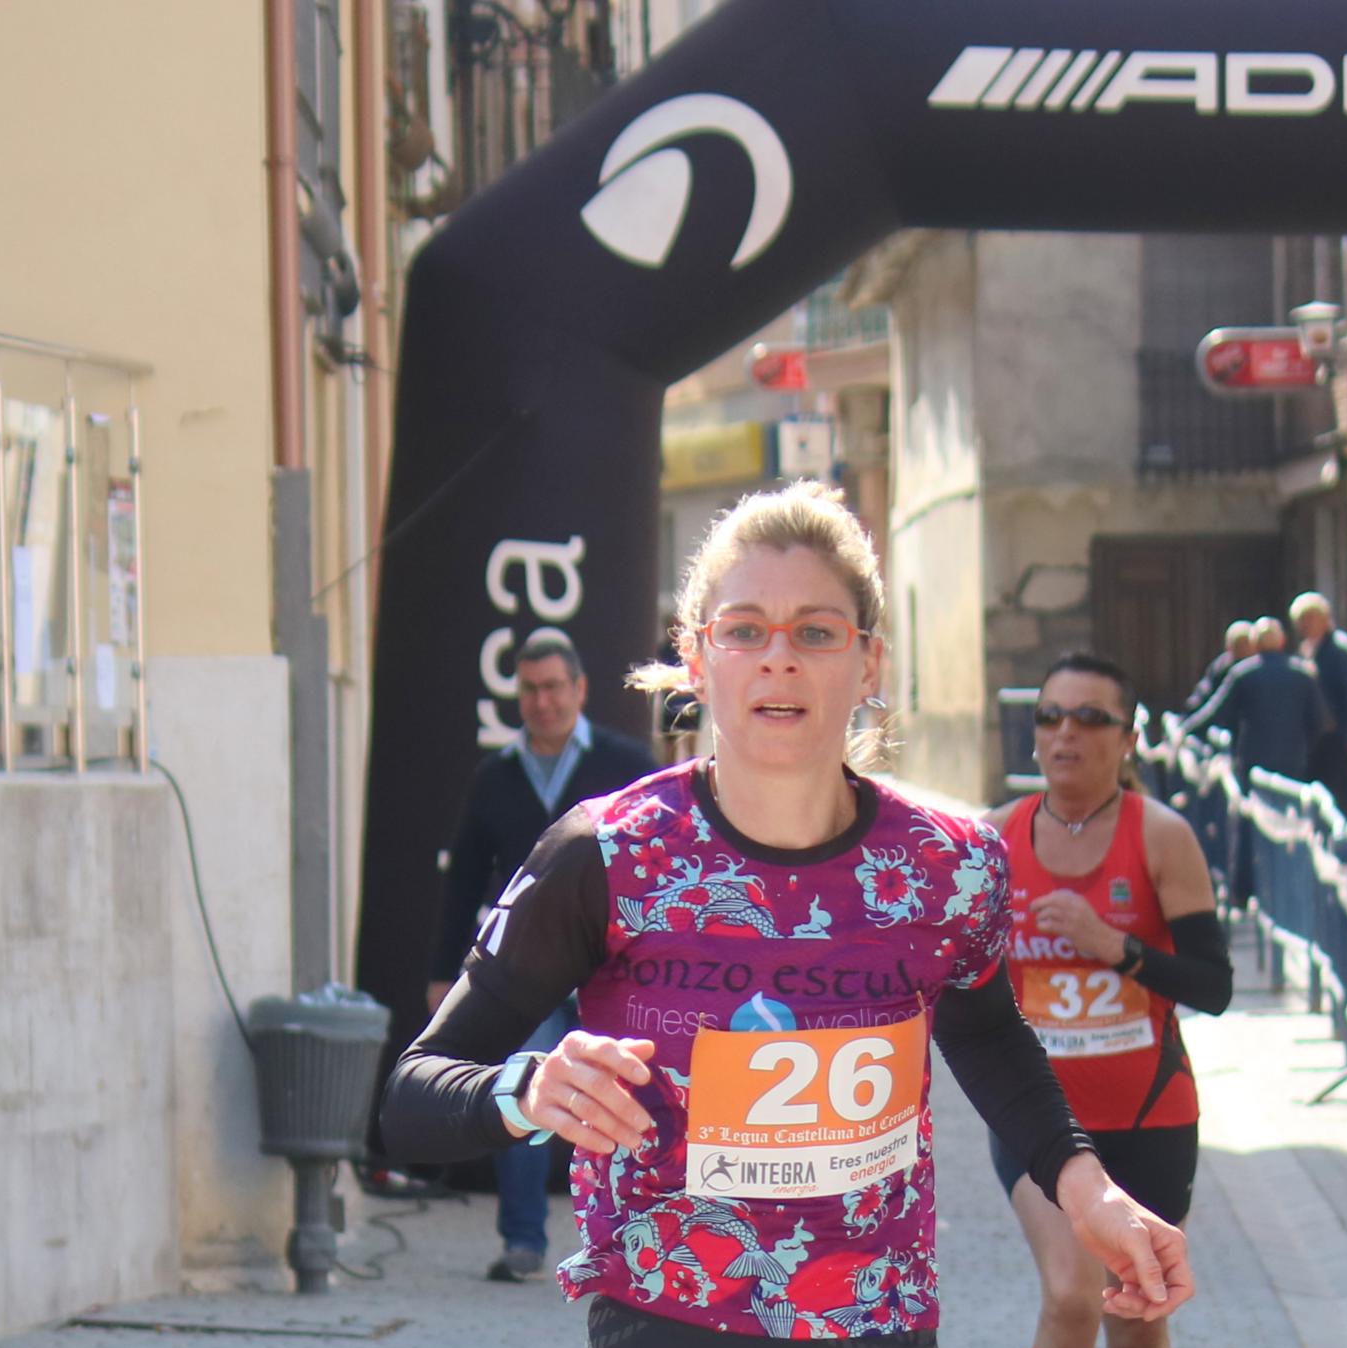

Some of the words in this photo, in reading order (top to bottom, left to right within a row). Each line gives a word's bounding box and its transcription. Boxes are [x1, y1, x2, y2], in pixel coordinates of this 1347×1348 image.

[1048, 970, 1125, 1020] 32
[745, 1037, 895, 1125] 26
[719, 1126, 769, 1145] Legua
[774, 1126, 854, 1144] Castellana
[859, 1119, 877, 1138] del
[880, 1104, 916, 1131] Cerrato
[830, 1155, 861, 1170] Eres
[865, 1133, 908, 1162] nuestra
[741, 1161, 816, 1185] INTEGRA
